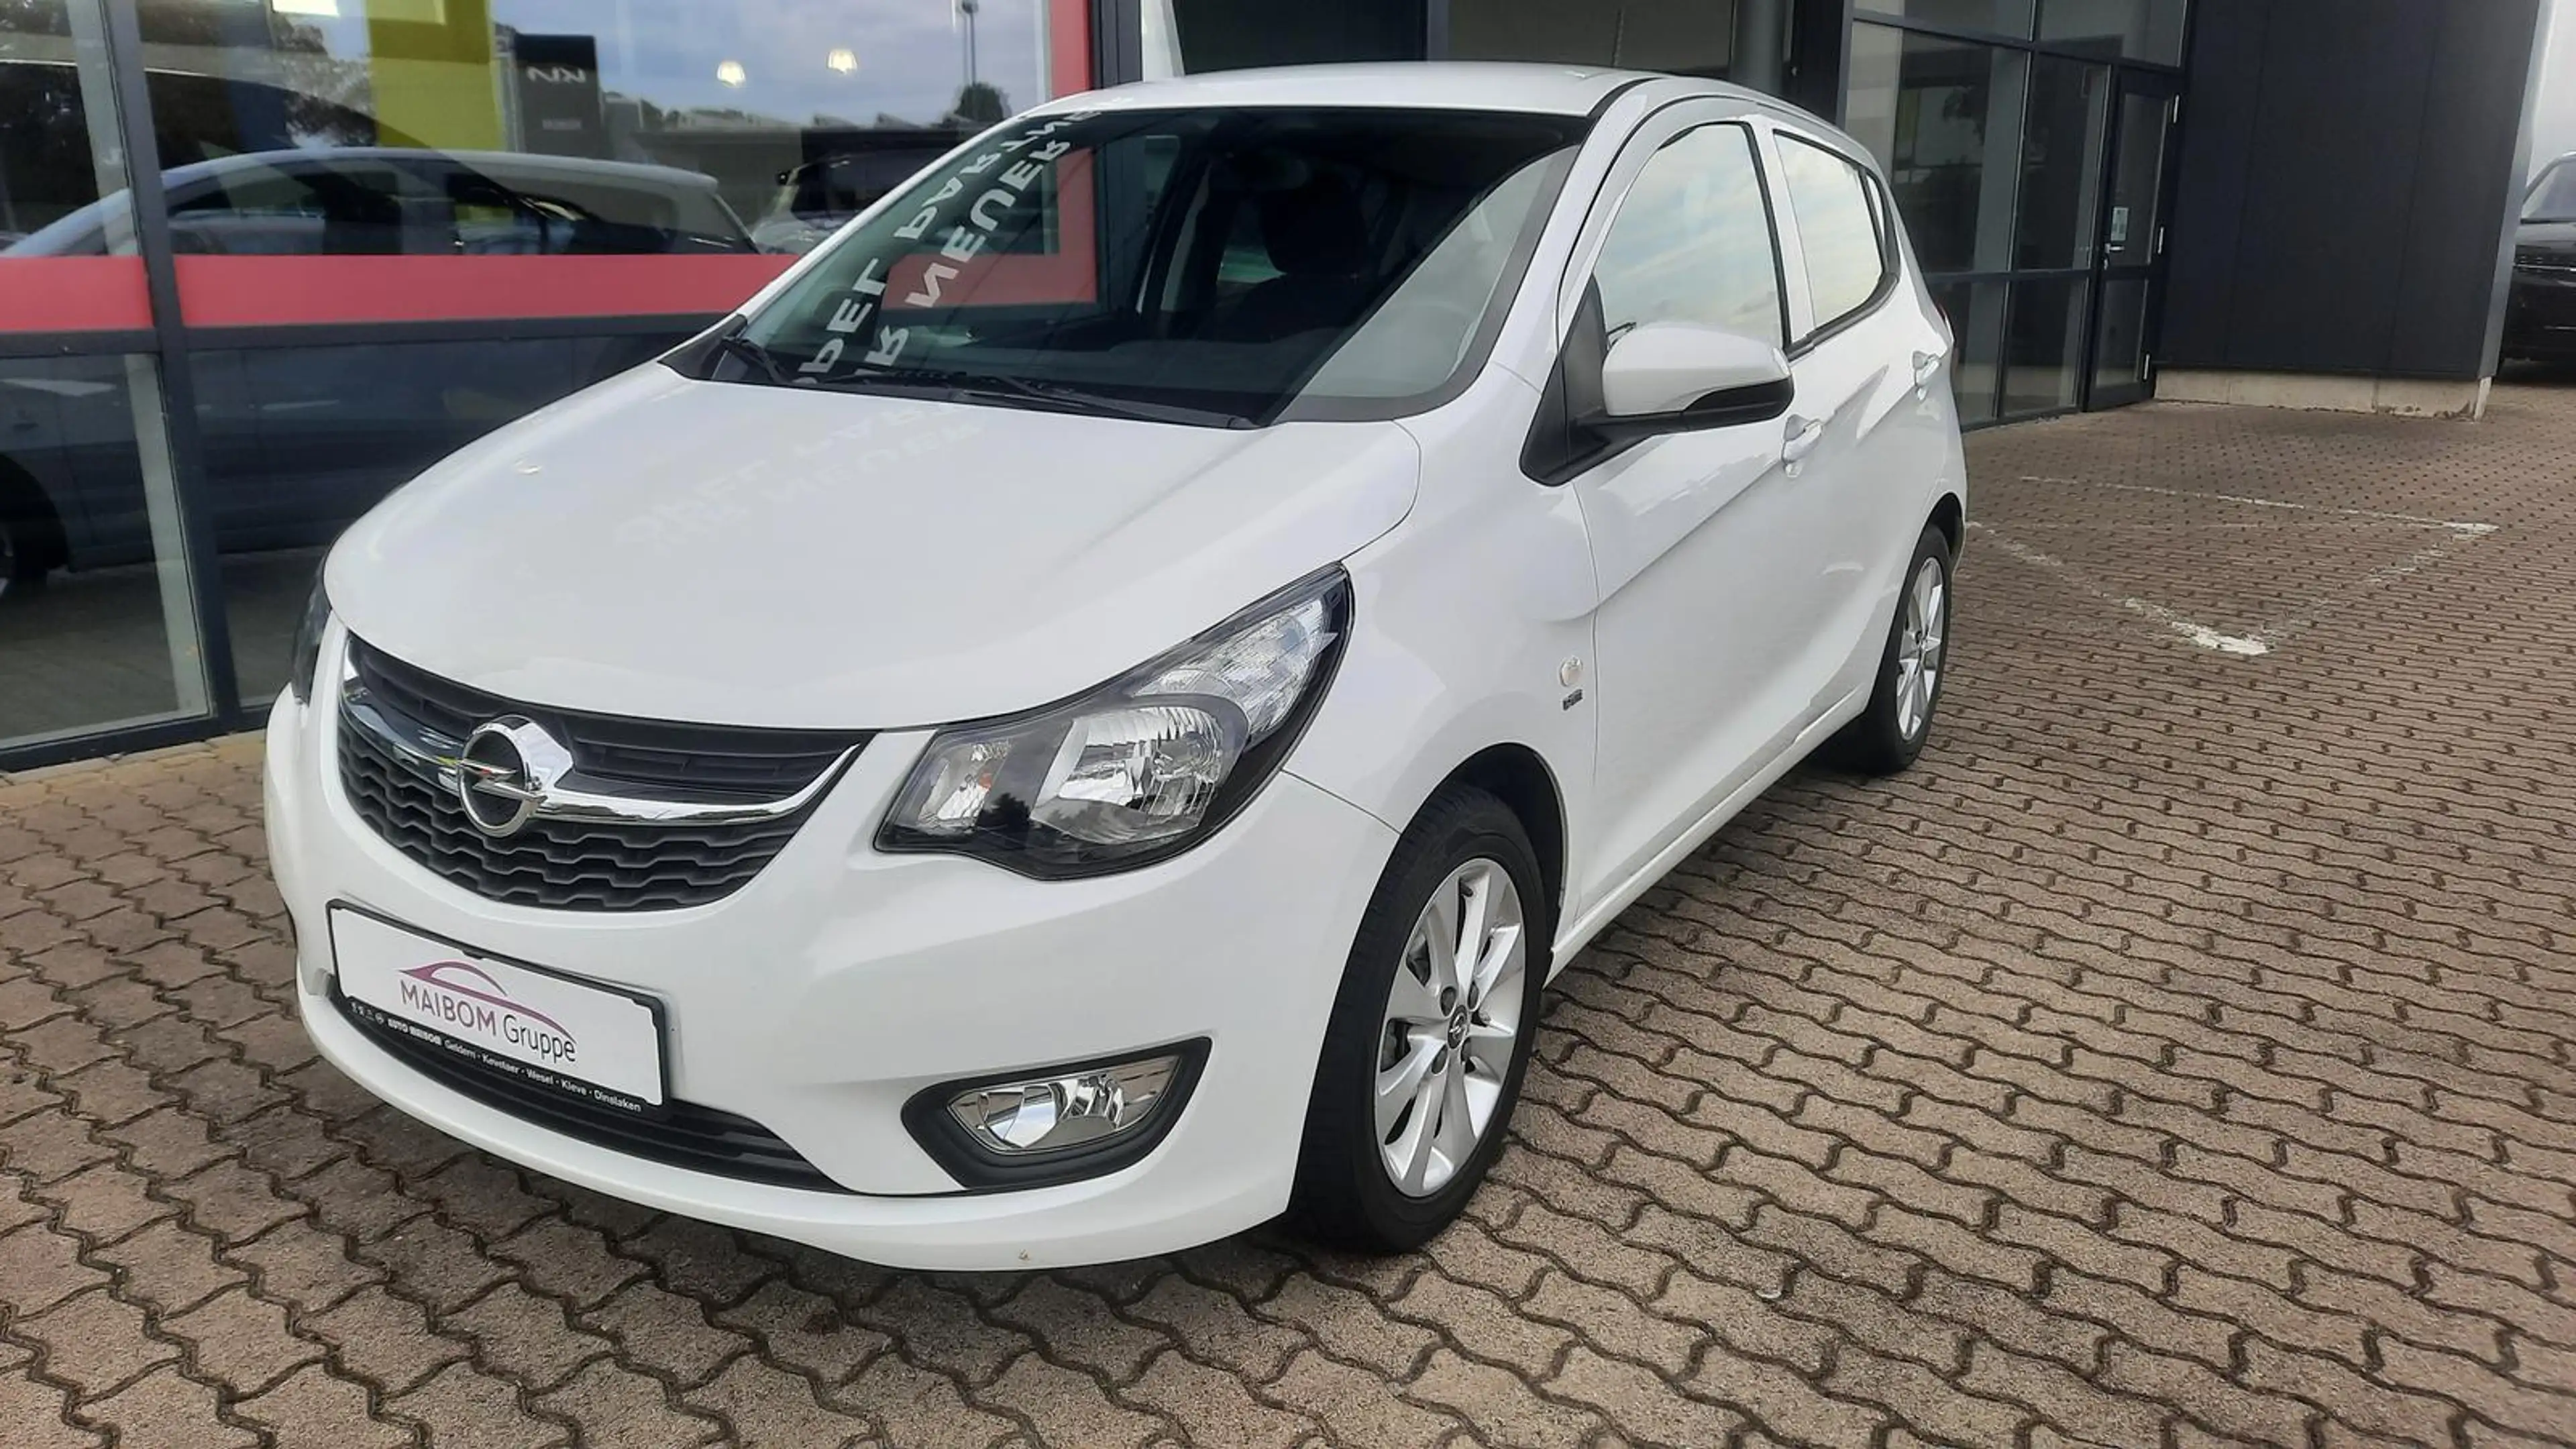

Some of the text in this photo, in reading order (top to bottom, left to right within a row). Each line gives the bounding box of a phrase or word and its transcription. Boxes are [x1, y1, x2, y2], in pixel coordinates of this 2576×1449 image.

[400, 979, 576, 1063] MAIBOM Gruppe
[526, 1068, 553, 1085] Wesel
[561, 1078, 588, 1096] Kleve
[593, 1089, 643, 1113] Dinslaken
